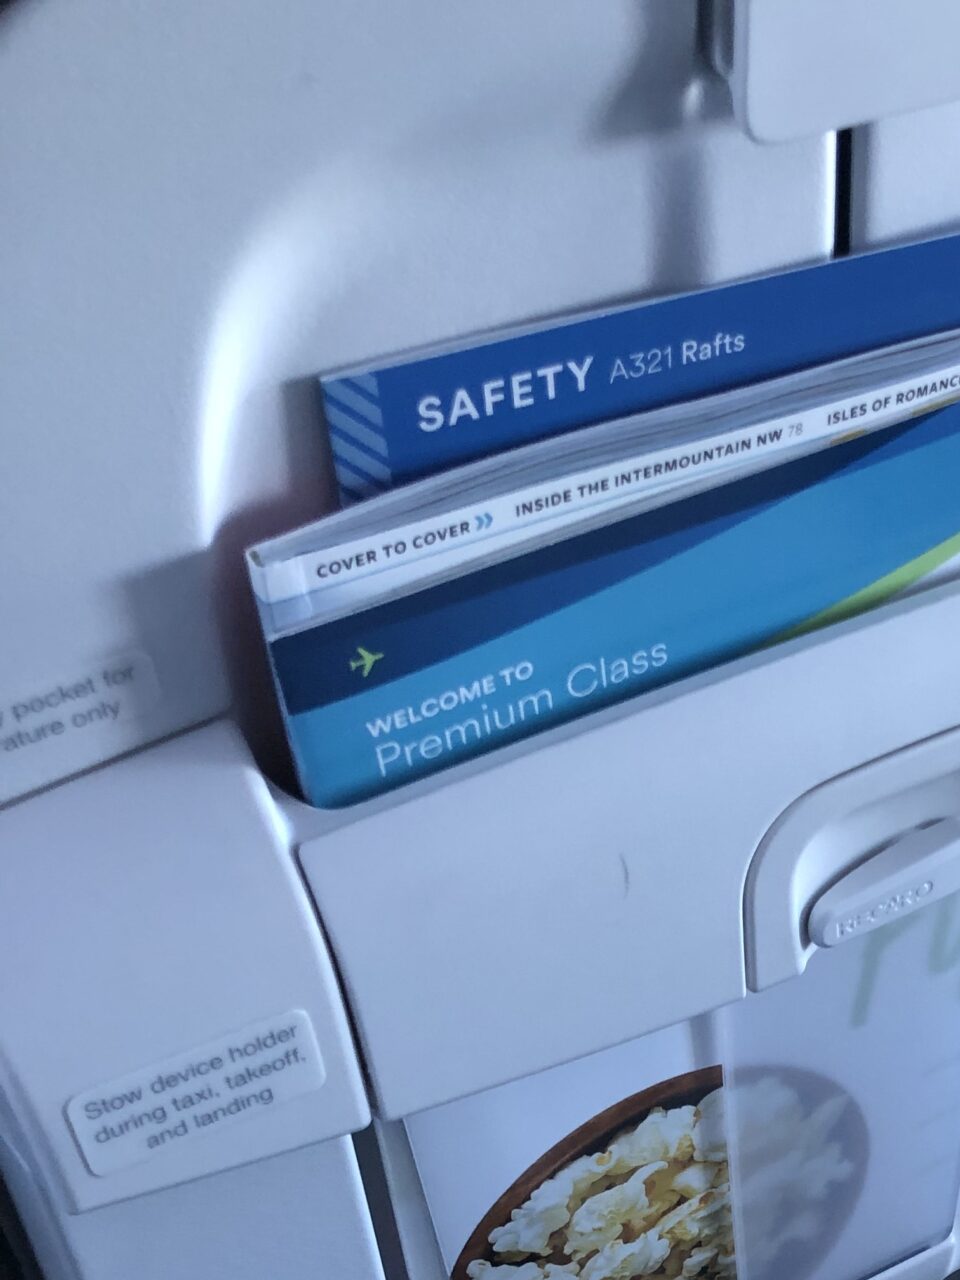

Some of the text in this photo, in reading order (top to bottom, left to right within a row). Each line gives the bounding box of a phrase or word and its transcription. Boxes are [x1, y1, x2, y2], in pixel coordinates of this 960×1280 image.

[416, 333, 746, 434] SAFETY A321 Rafts
[826, 402, 868, 426] ISLES
[872, 395, 892, 413] OF
[514, 422, 804, 518] INSIDE THE INTERMOUNTAIN NW 78
[316, 520, 471, 579] COVER TO COVER
[12, 677, 96, 722] pocket
[71, 701, 120, 729] only
[366, 661, 534, 738] WELCOME TO
[375, 642, 668, 777] Premium Class
[83, 1024, 298, 1121] Stow device holder
[94, 1047, 307, 1145] during taxi, takeoff,
[146, 1087, 275, 1149] and landing
